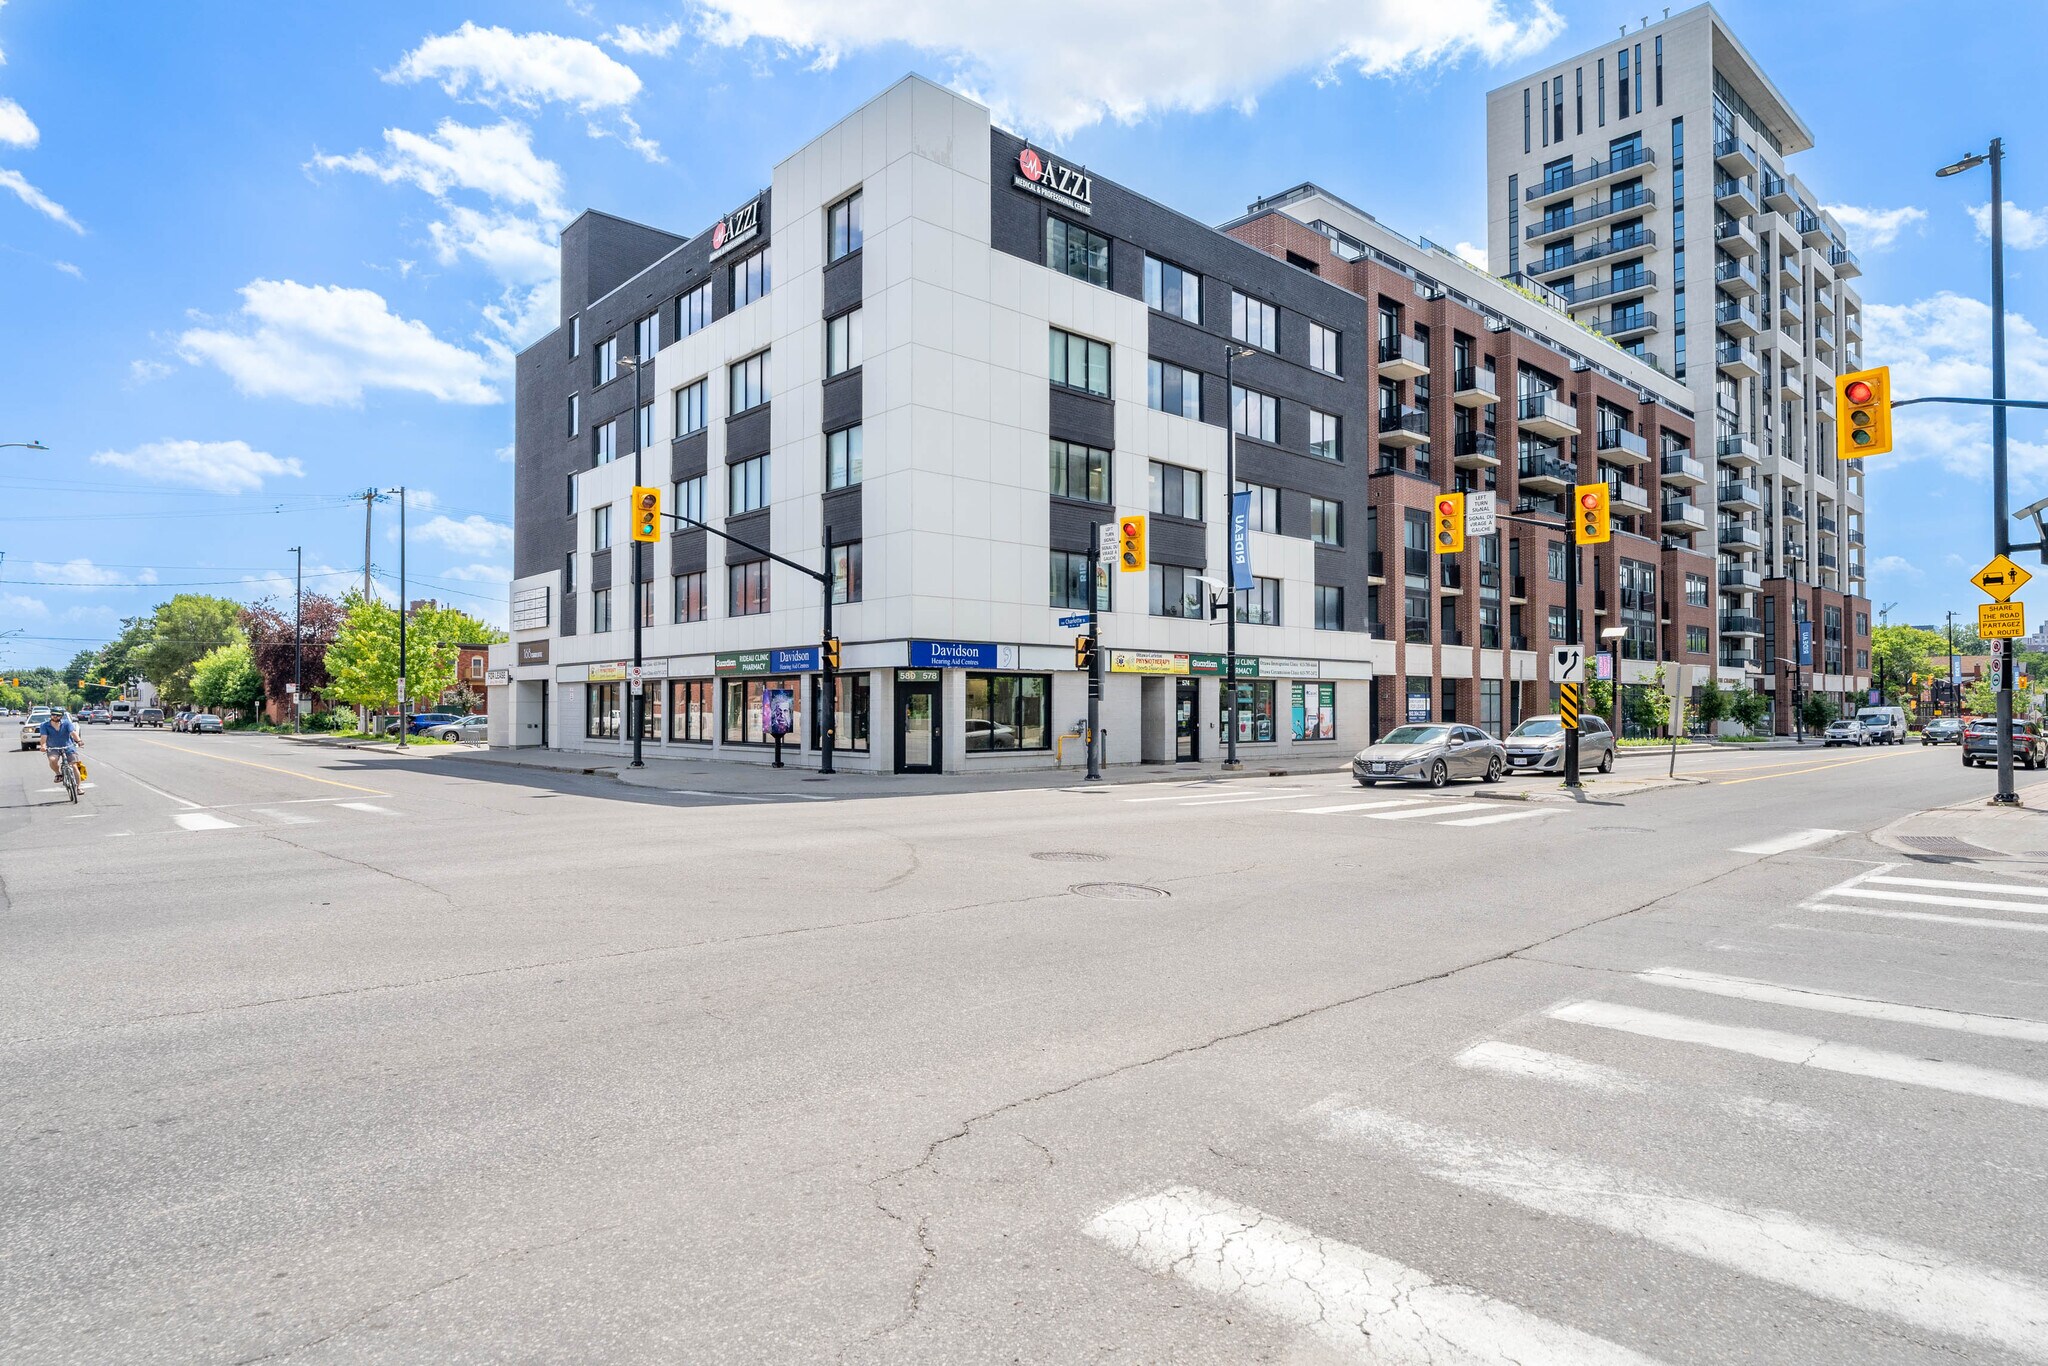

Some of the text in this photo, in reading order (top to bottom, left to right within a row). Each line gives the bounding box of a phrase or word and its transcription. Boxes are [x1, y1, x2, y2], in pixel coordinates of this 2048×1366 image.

[1015, 176, 1036, 193] MEDICAL
[1041, 187, 1075, 208] PROFESSIONAL
[1074, 202, 1091, 215] CENTRE
[931, 643, 979, 657] Davidson
[716, 653, 769, 667] Guardian RIDEAU CLINIC
[780, 650, 810, 663] Davidson
[931, 658, 951, 666] Hearing
[1192, 660, 1218, 668] Guardian
[742, 663, 766, 671] PHARMACY
[495, 671, 506, 680] LEASE
[922, 672, 938, 680] 578
